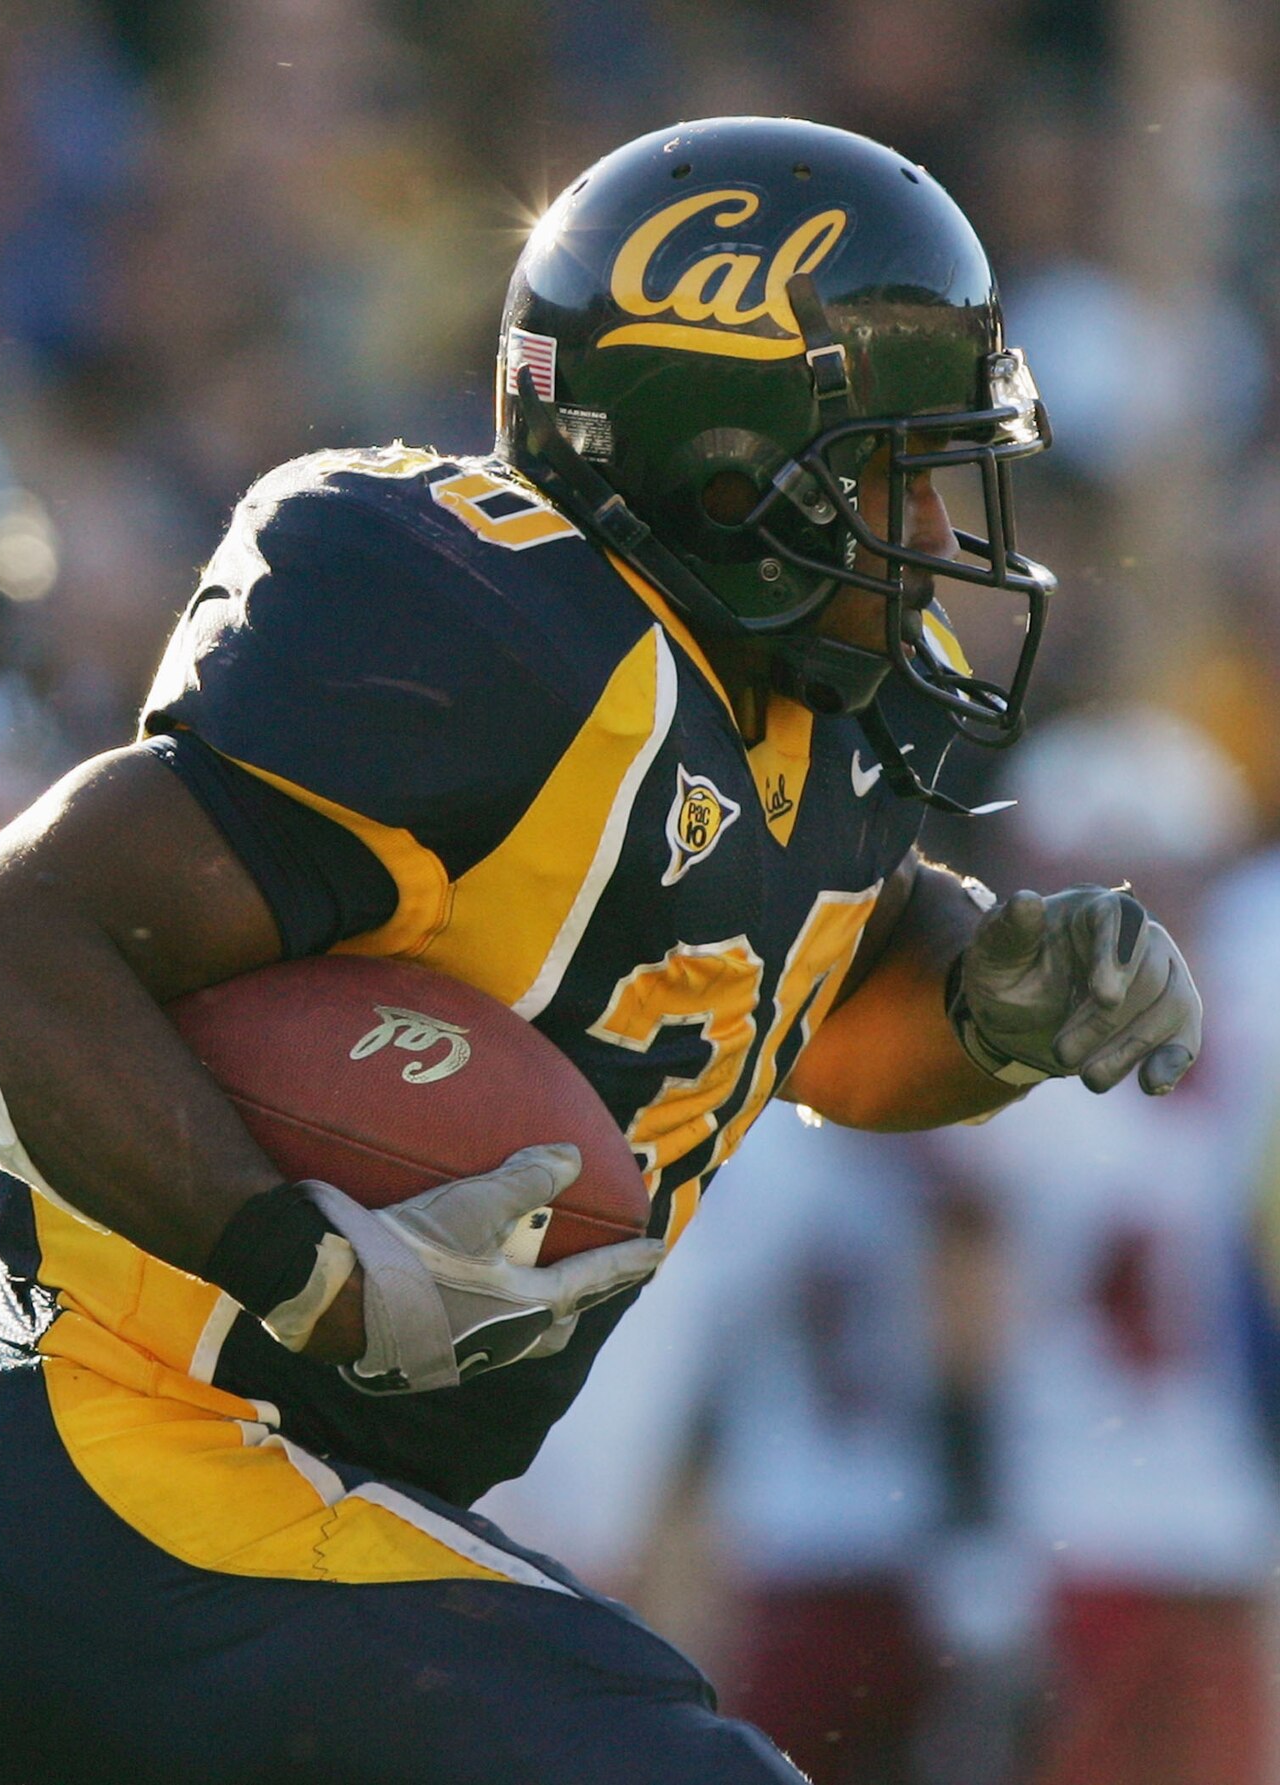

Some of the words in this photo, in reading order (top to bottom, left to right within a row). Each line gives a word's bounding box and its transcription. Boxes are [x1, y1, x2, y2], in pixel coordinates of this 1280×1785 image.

[597, 188, 846, 361] Cal
[764, 773, 793, 823] Cal
[686, 821, 707, 848] 10
[349, 1004, 471, 1084] Cal
